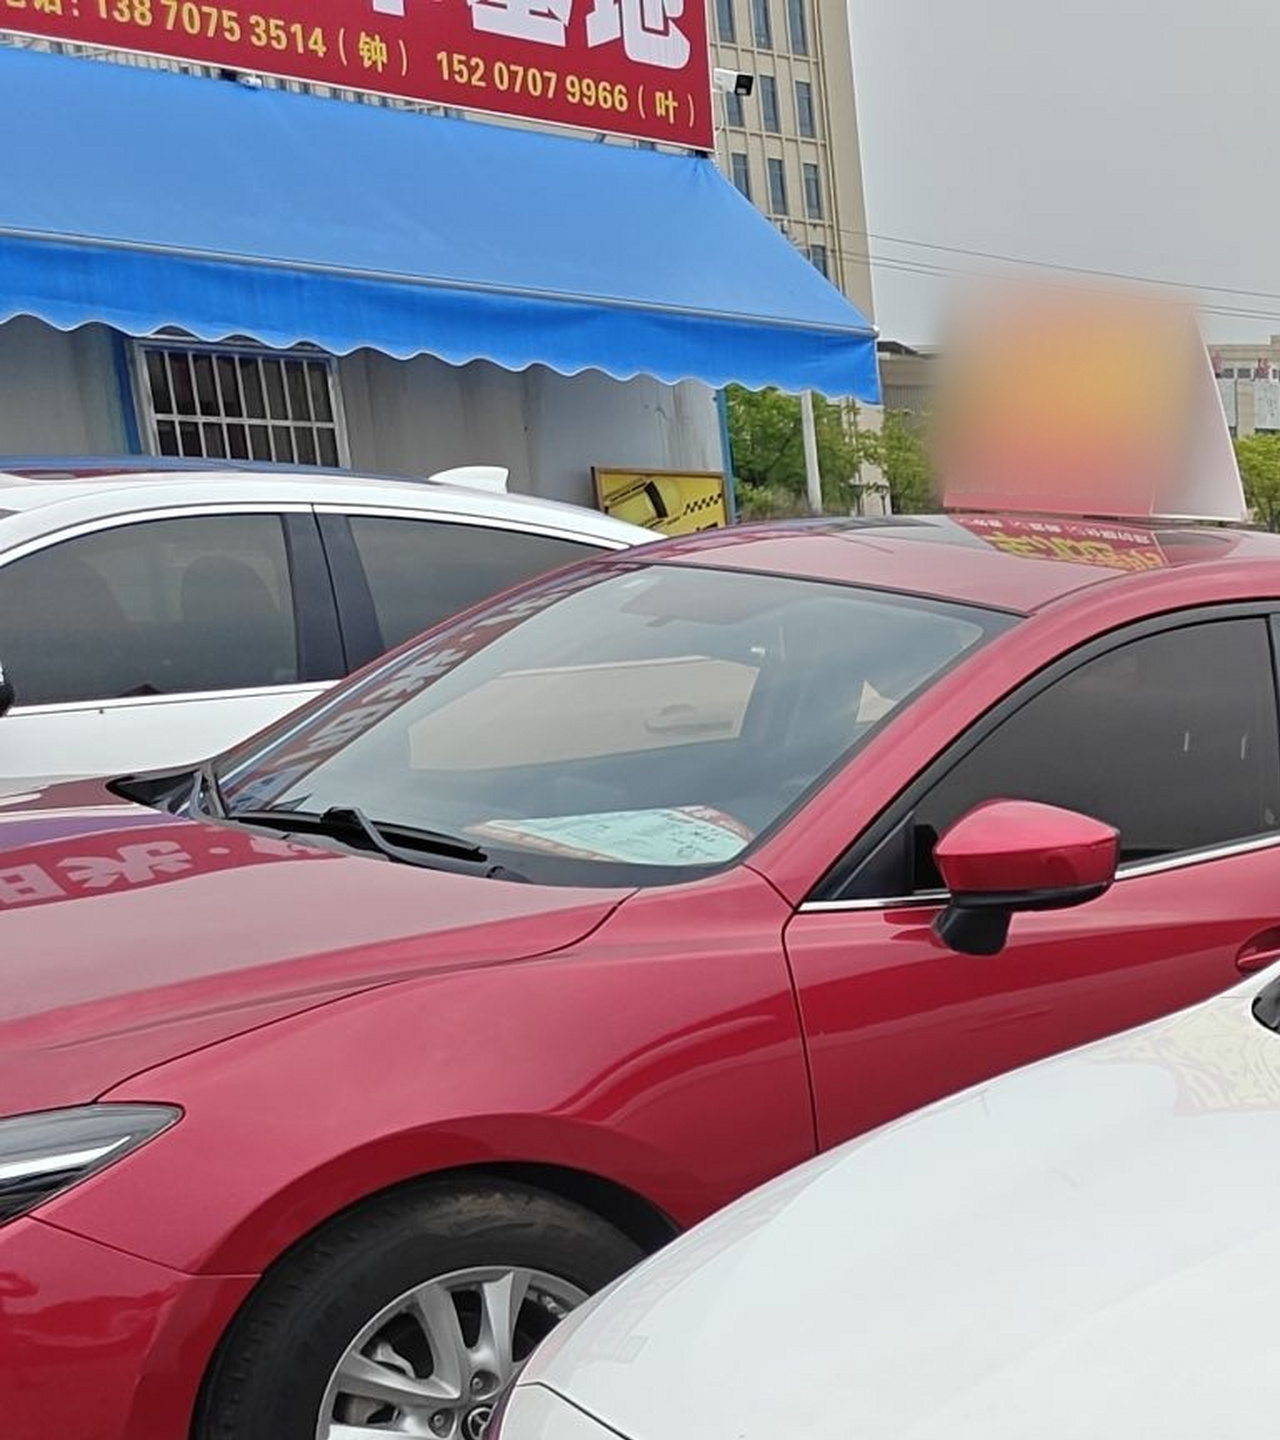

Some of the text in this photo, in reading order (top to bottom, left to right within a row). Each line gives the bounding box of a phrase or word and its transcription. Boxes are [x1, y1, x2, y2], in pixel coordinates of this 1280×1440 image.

[160, 0, 241, 43] 7075
[437, 51, 486, 88] 152
[494, 60, 558, 99] 0707
